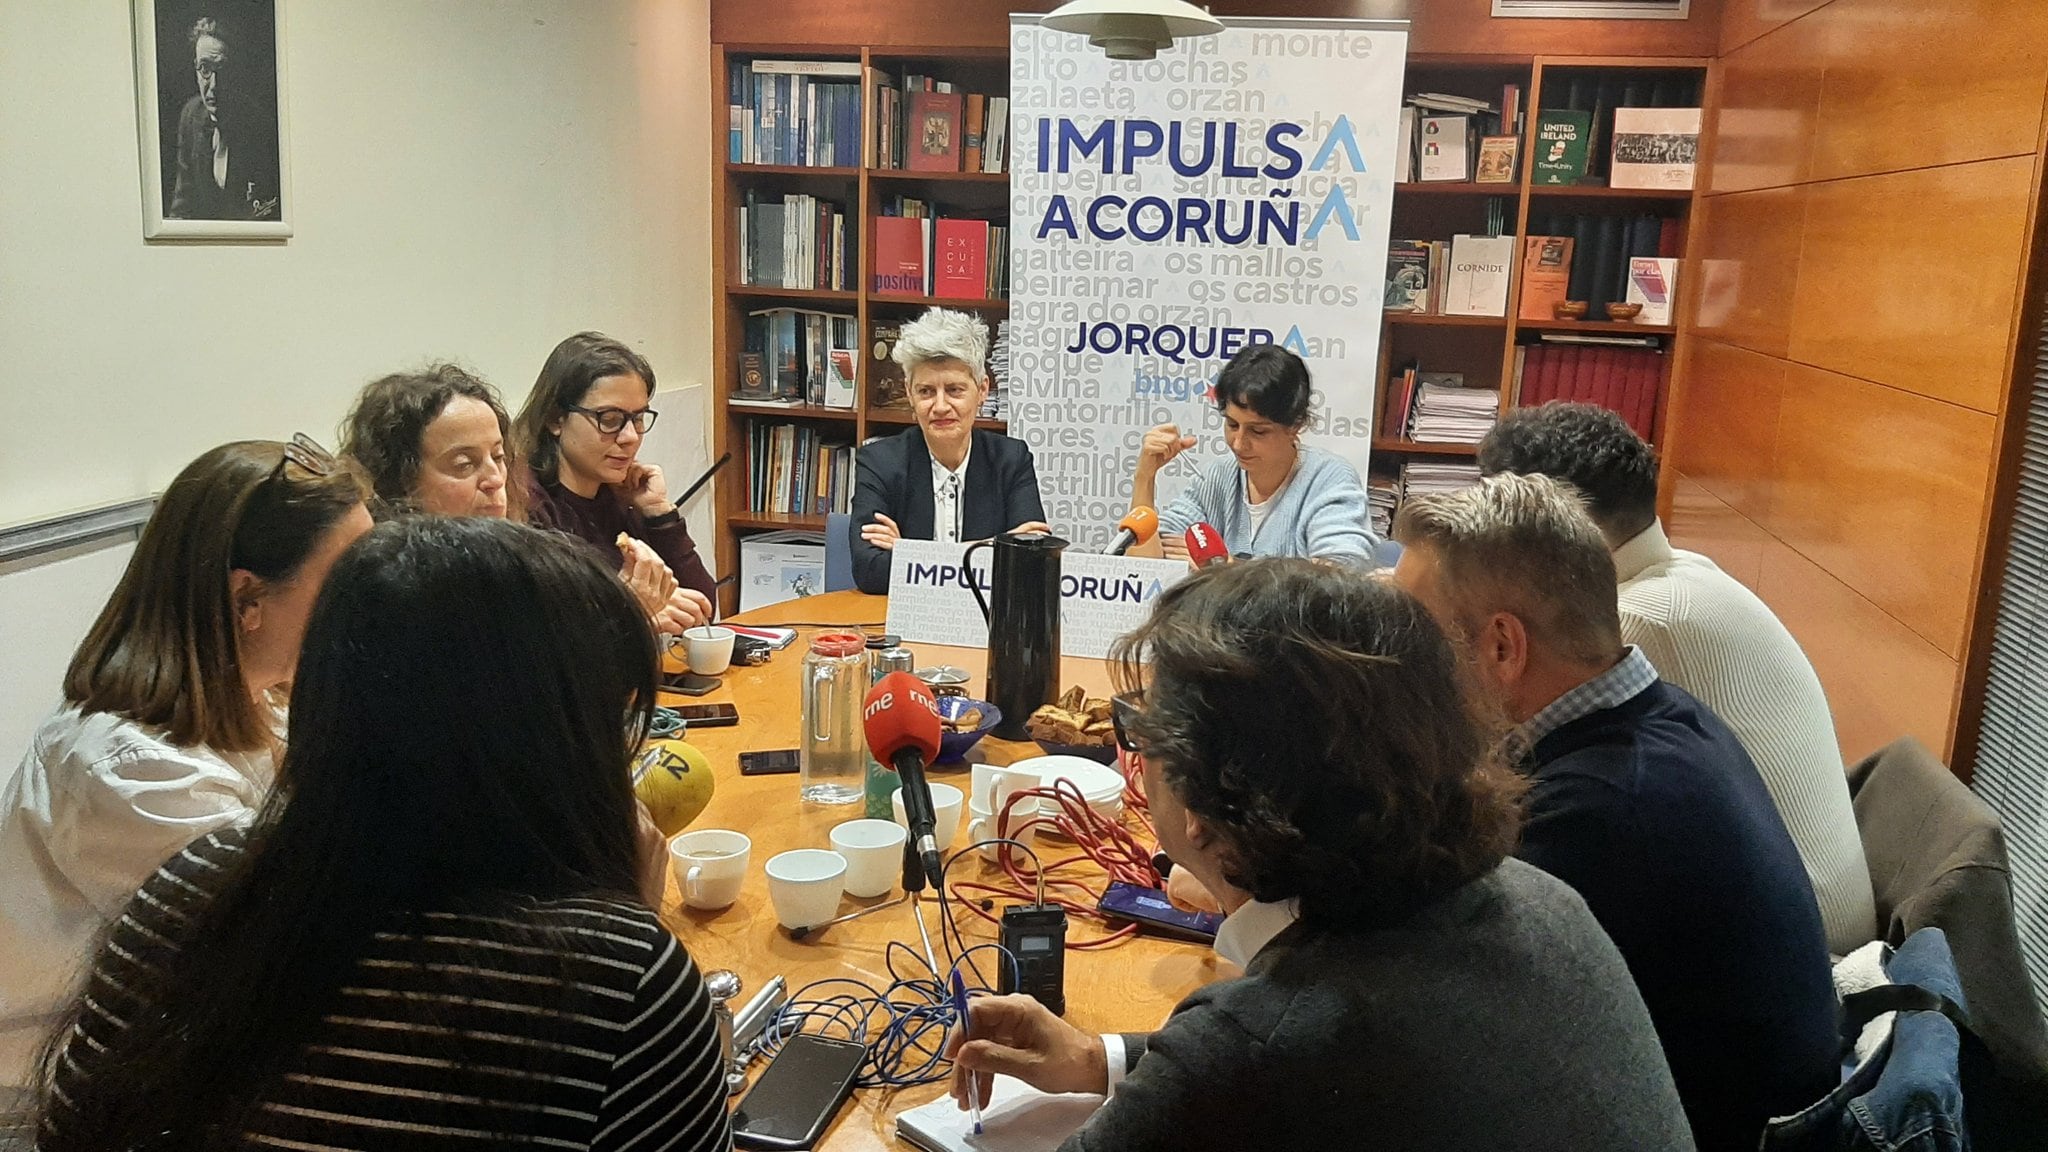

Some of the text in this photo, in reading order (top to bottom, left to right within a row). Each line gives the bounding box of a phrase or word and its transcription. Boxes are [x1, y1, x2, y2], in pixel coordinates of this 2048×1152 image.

[1251, 29, 1373, 59] monte
[1013, 49, 1248, 84] alto atochas
[1012, 77, 1136, 110] zalaeta
[1540, 131, 1577, 141] IRELAND
[1543, 123, 1575, 132] UNITED
[1037, 114, 1367, 181] IMPULSA
[1036, 194, 1079, 239] A
[1012, 246, 1324, 279] gaiteira os mallos
[1456, 263, 1504, 273] CORNIDE
[1012, 271, 1359, 308] beiramar os castros
[1010, 300, 1079, 329] agra
[1086, 294, 1131, 323] do
[1010, 325, 1077, 353] sagr
[1010, 351, 1104, 379] roque
[1134, 367, 1190, 402] bng
[1009, 398, 1173, 426] ventorrillo
[906, 562, 993, 590] IMPUL
[1060, 572, 1163, 604] ORUÑA
[864, 689, 939, 721] rne rne
